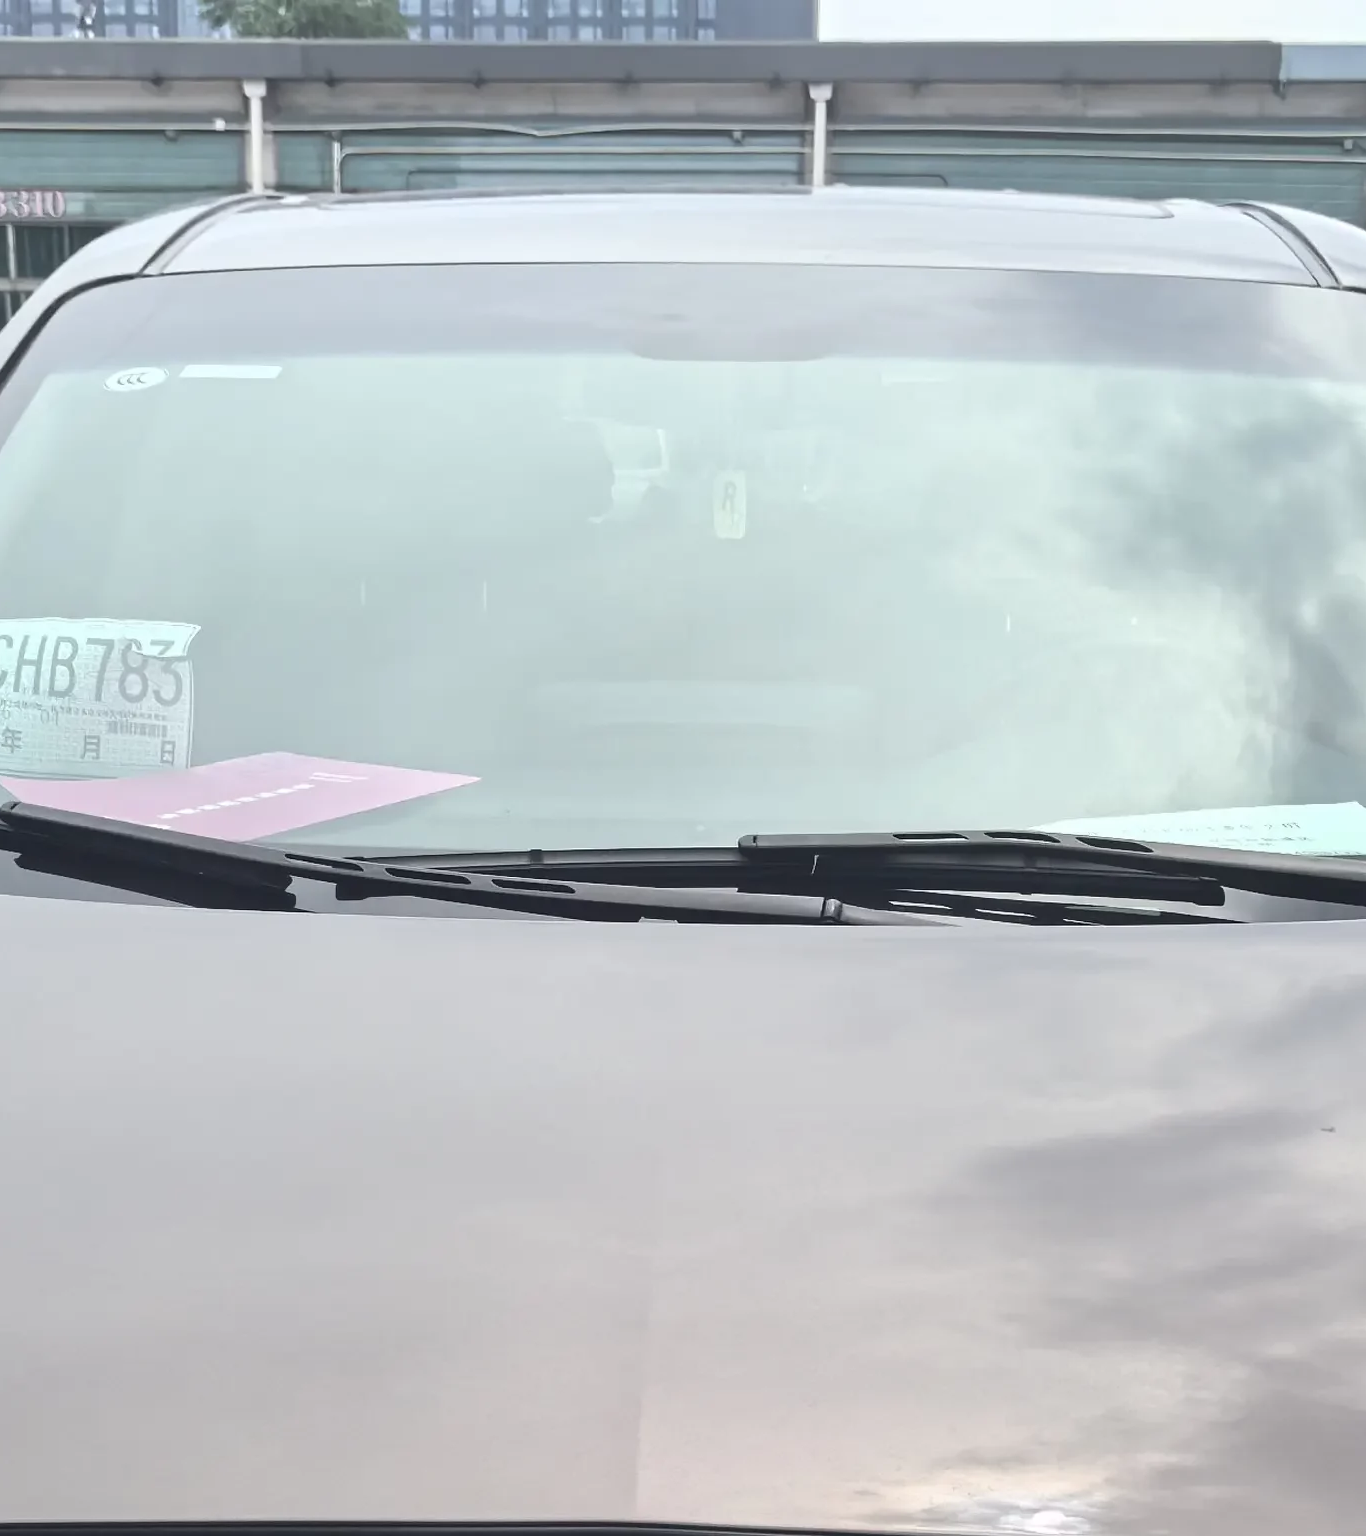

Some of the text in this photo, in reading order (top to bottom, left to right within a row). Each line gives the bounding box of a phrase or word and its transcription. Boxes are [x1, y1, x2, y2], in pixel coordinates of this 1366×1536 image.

[1, 726, 176, 766] 年 月 日
